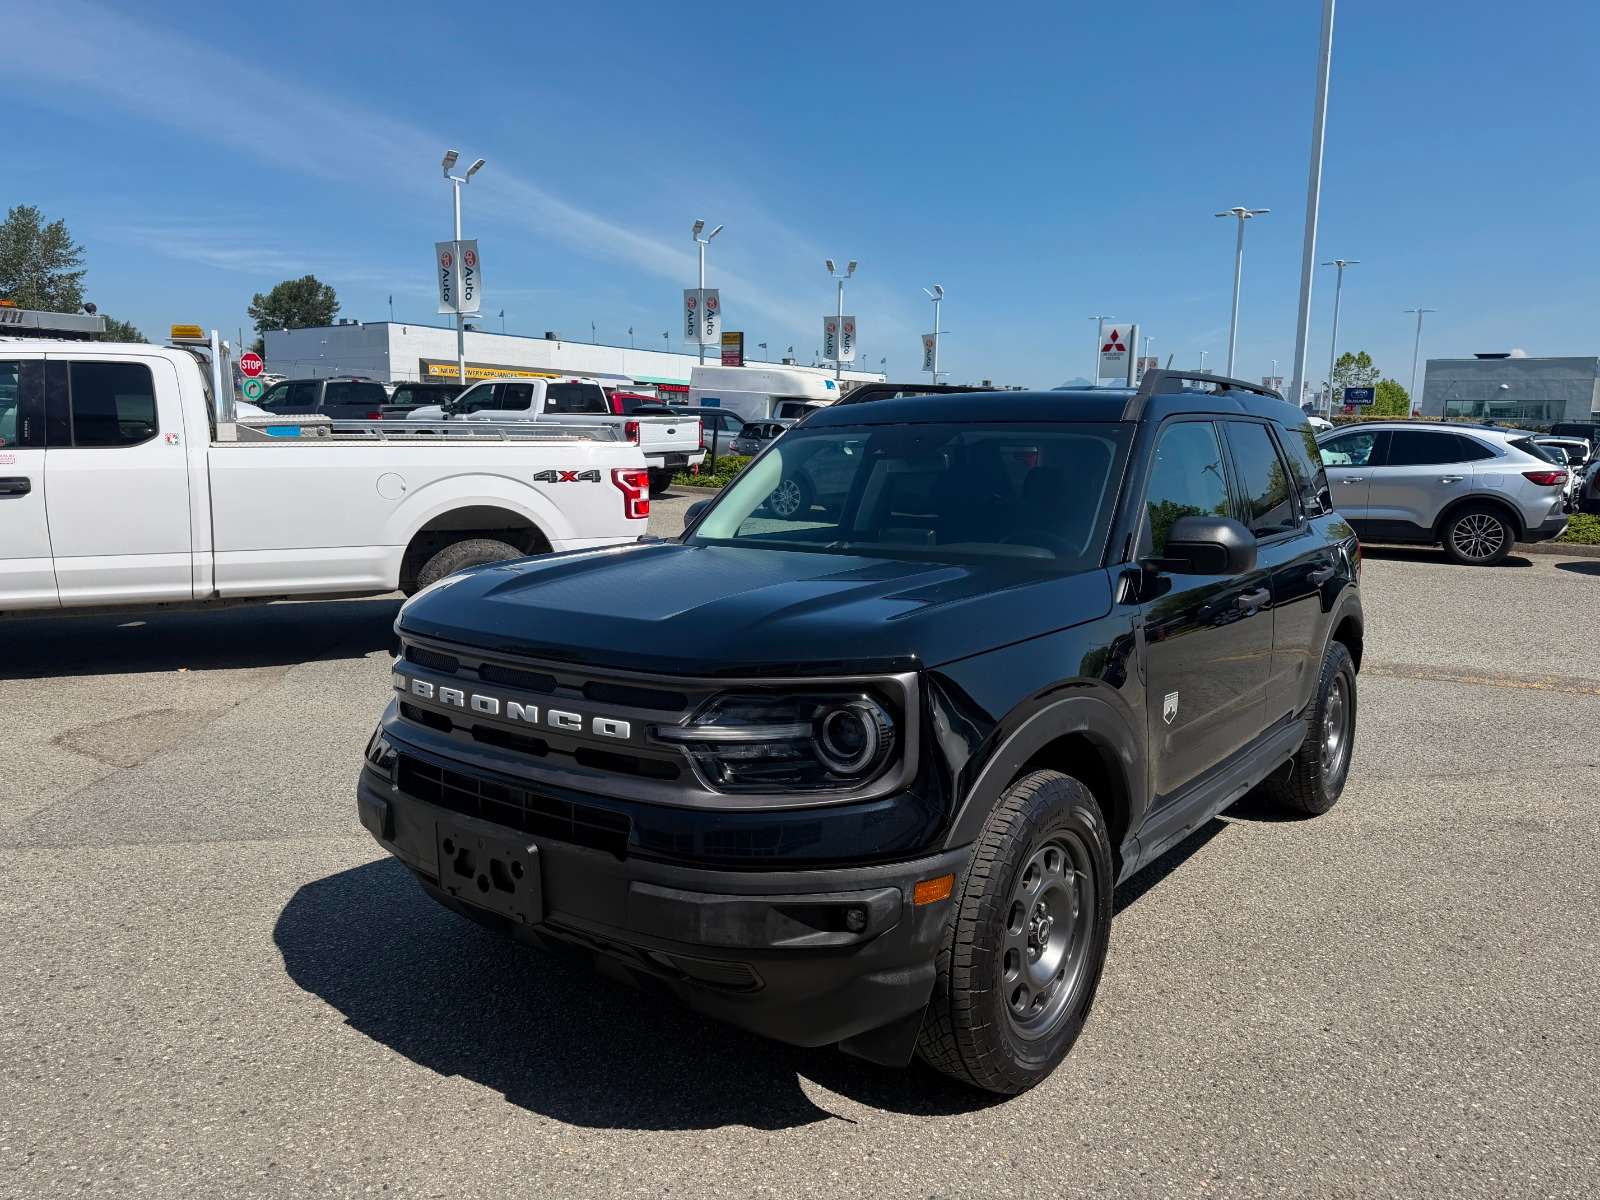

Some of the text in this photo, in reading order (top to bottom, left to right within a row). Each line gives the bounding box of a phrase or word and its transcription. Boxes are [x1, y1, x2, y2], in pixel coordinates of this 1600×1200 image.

[442, 268, 451, 302] Auto
[464, 266, 474, 301] Auto
[687, 309, 695, 336] Auto
[706, 309, 715, 336] Auto
[242, 359, 261, 370] STOP
[440, 367, 455, 375] NEW
[455, 368, 483, 377] CUNTRY
[411, 678, 631, 739] BRONCO
